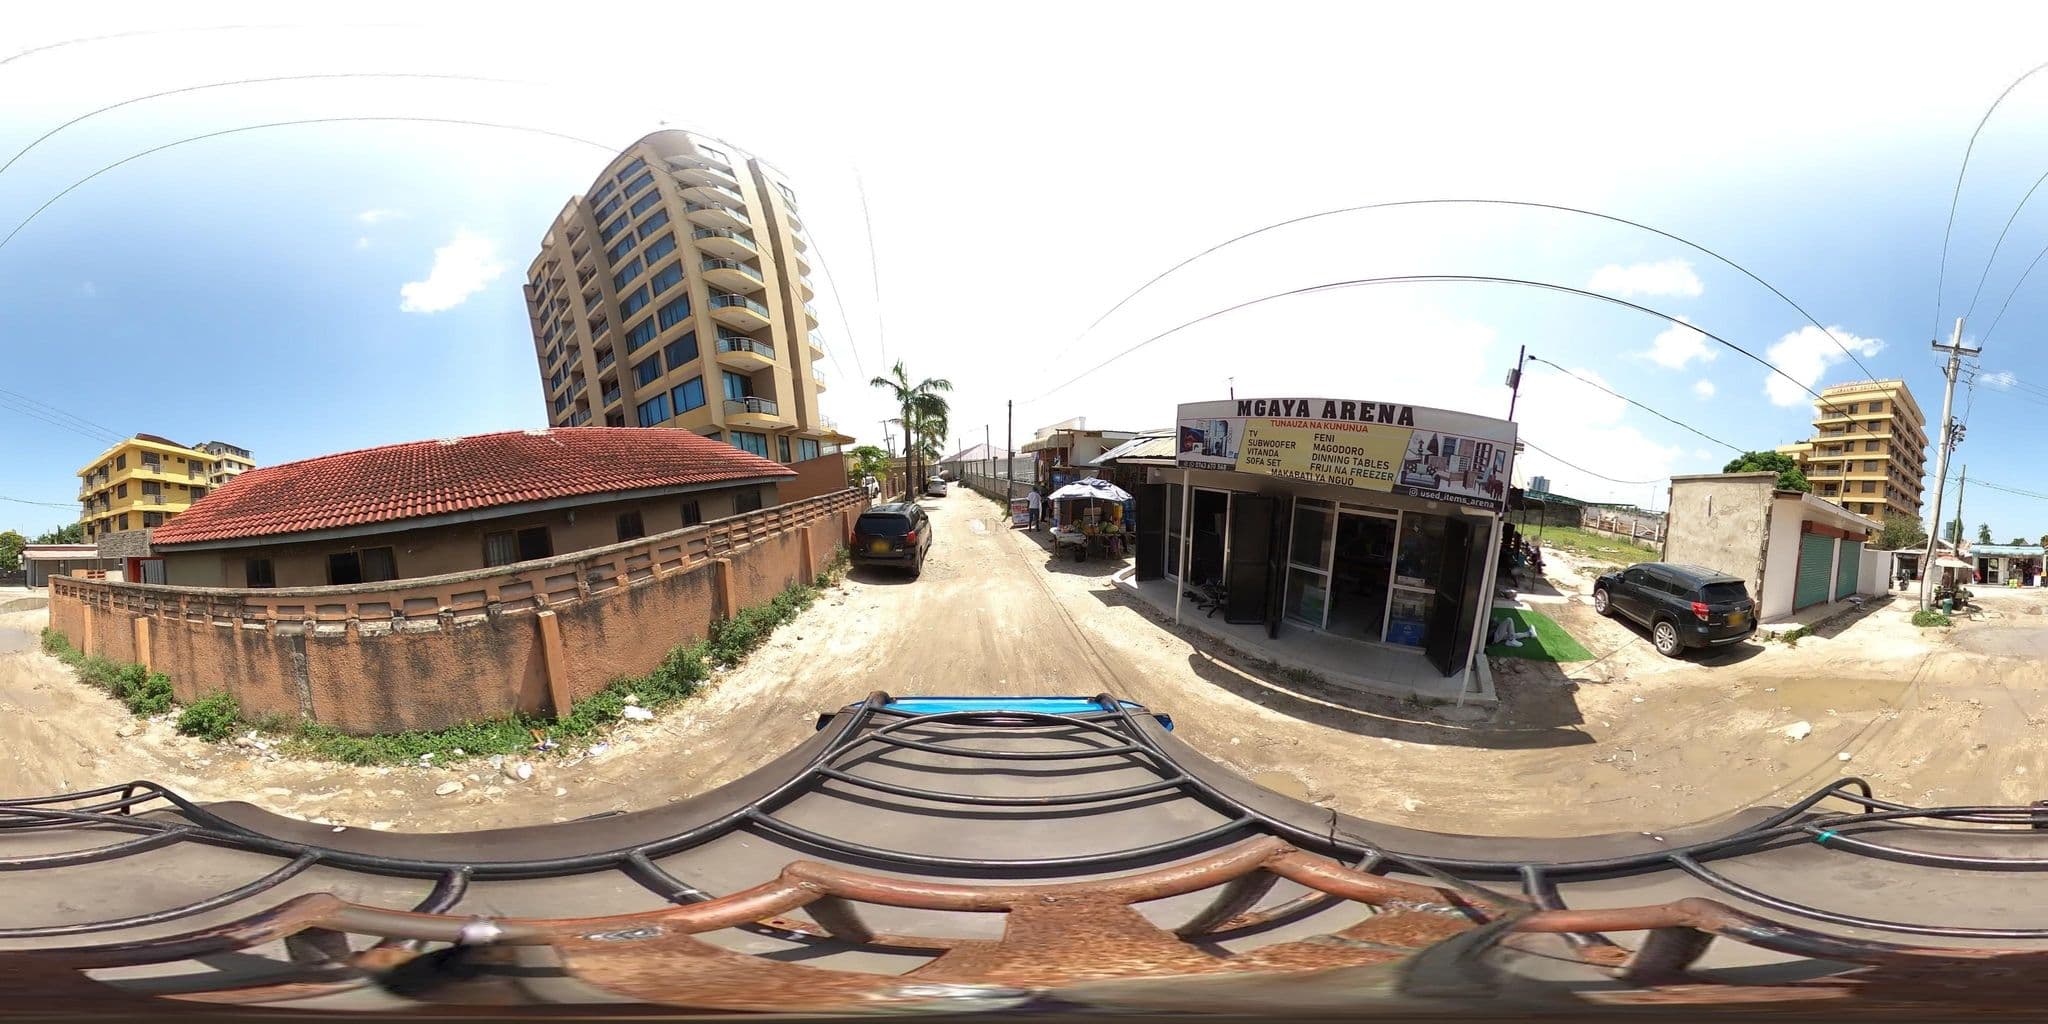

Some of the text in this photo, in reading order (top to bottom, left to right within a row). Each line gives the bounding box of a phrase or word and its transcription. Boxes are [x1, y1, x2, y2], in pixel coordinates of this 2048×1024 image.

[1237, 399, 1414, 427] MGAYA ARENA
[1271, 420, 1369, 433] TUNAUZA NA KUNUNUA
[1247, 439, 1297, 449] SUBWOOFER
[1314, 433, 1335, 442] FENI
[1247, 448, 1279, 457] VITANDA
[1312, 443, 1365, 456] MAGODORO
[1246, 456, 1282, 467] SOFA SET
[1311, 453, 1390, 470] DINNING TABLES
[1271, 468, 1354, 486] MAKABATI YA NGUO
[1310, 462, 1395, 481] FRIJI NA FREEZER
[1420, 491, 1495, 508] used_items_arena
